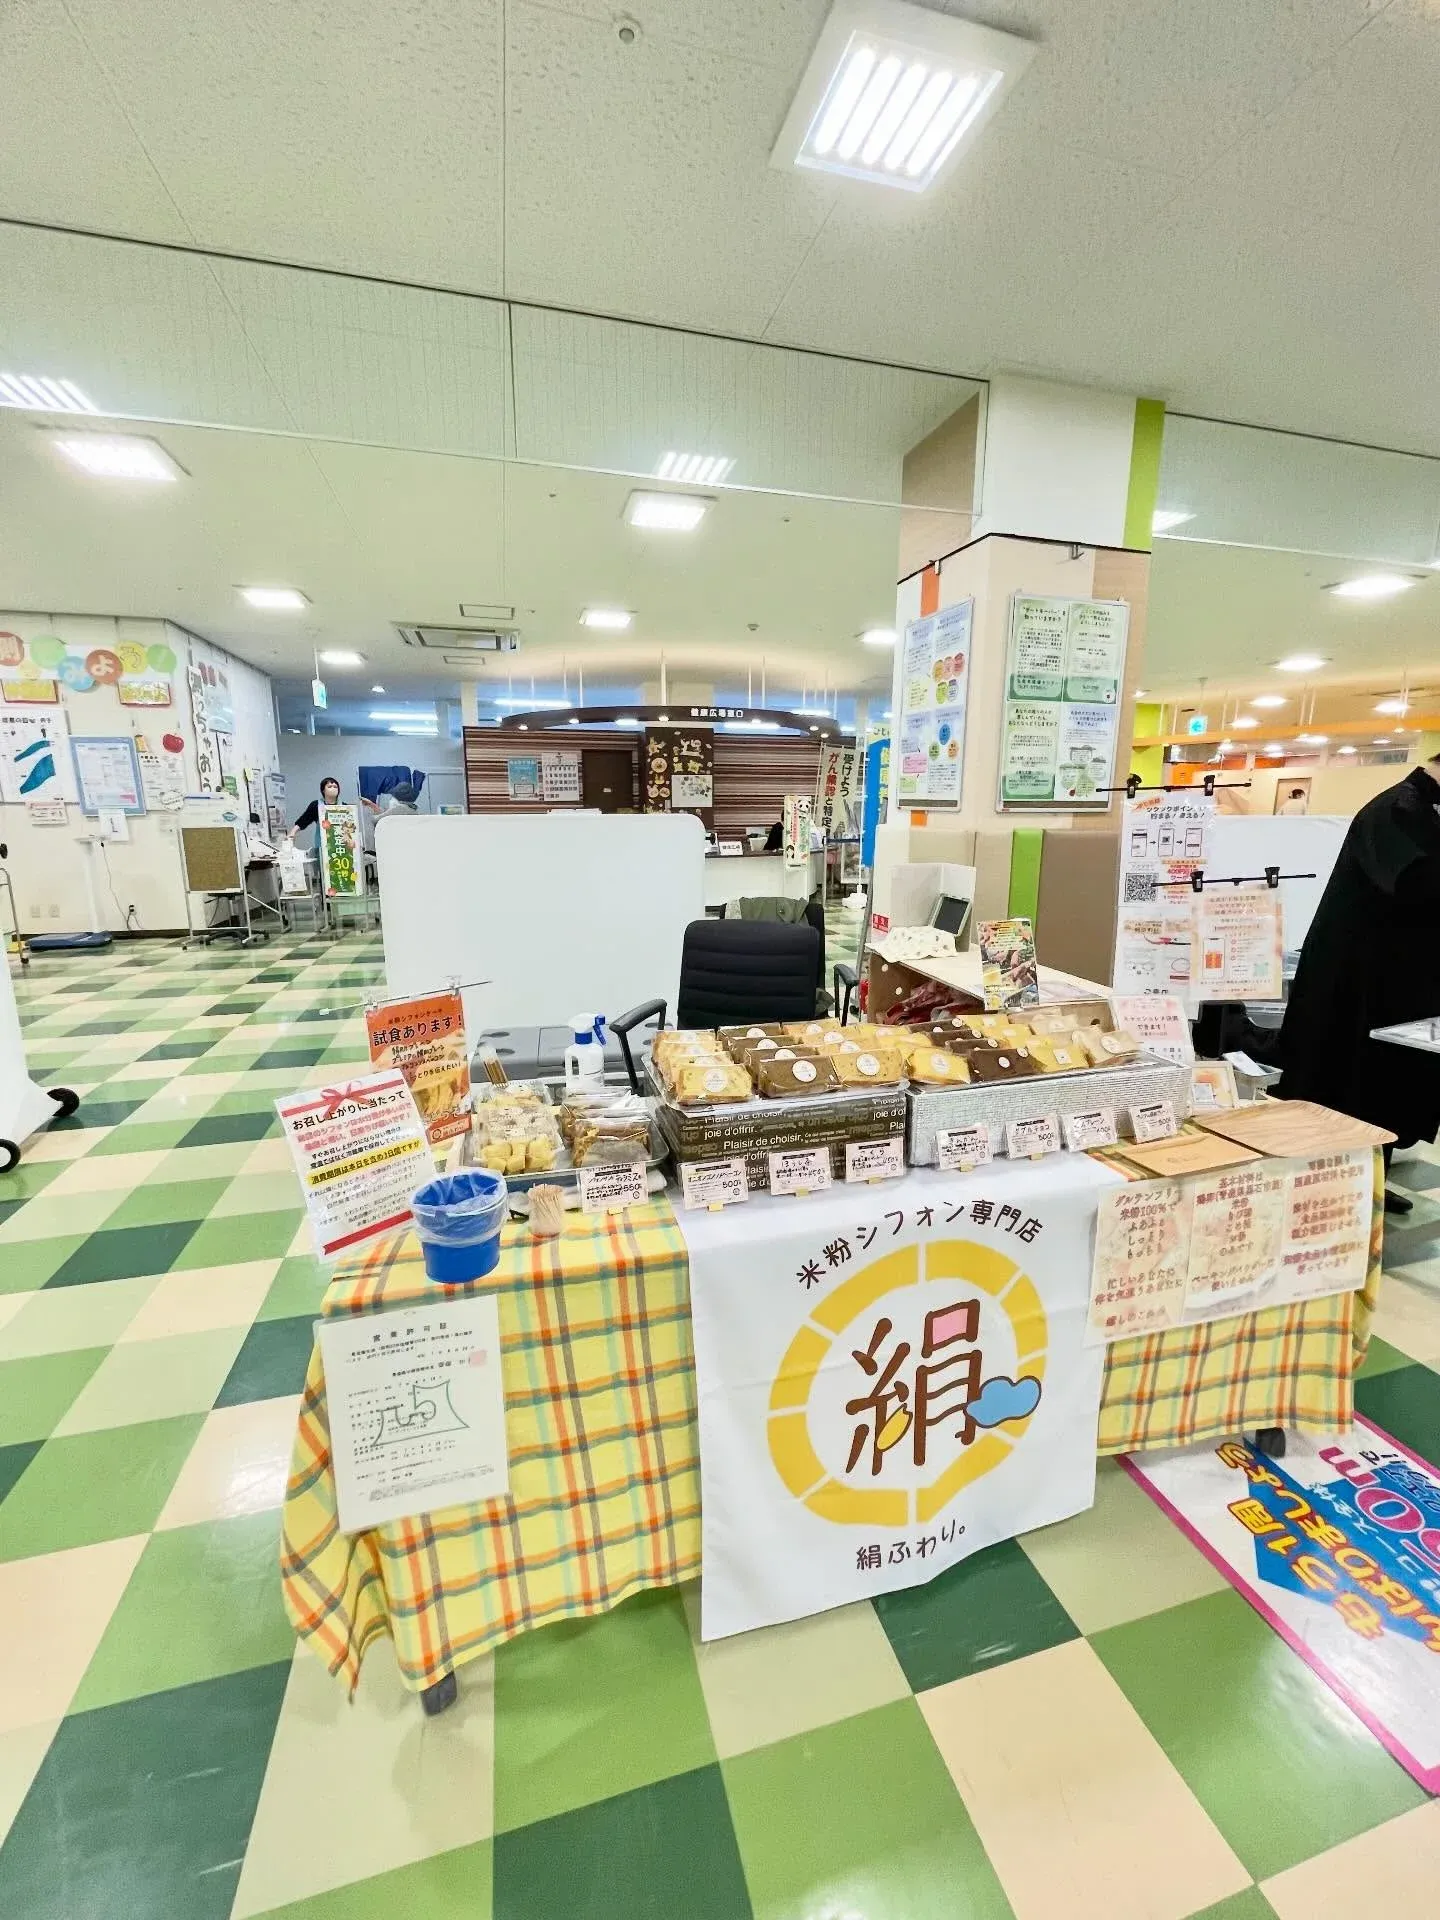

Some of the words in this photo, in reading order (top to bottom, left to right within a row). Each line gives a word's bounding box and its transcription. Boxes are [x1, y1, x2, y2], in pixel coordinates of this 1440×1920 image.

[840, 753, 855, 798] 受けよう
[333, 858, 350, 870] 30
[372, 1014, 462, 1046] 試食あります！
[292, 1090, 406, 1131] お召し上がりに当たって
[704, 1129, 722, 1140] joie
[724, 1135, 753, 1149] Plaisir
[755, 1137, 768, 1147] de
[769, 1132, 803, 1146] choisir,
[796, 1199, 1043, 1290] 米粉シフォン専門店
[846, 1299, 982, 1476] 絹
[856, 1520, 967, 1571] 絹ふわり。
[1227, 1494, 1384, 1641] もう1周
